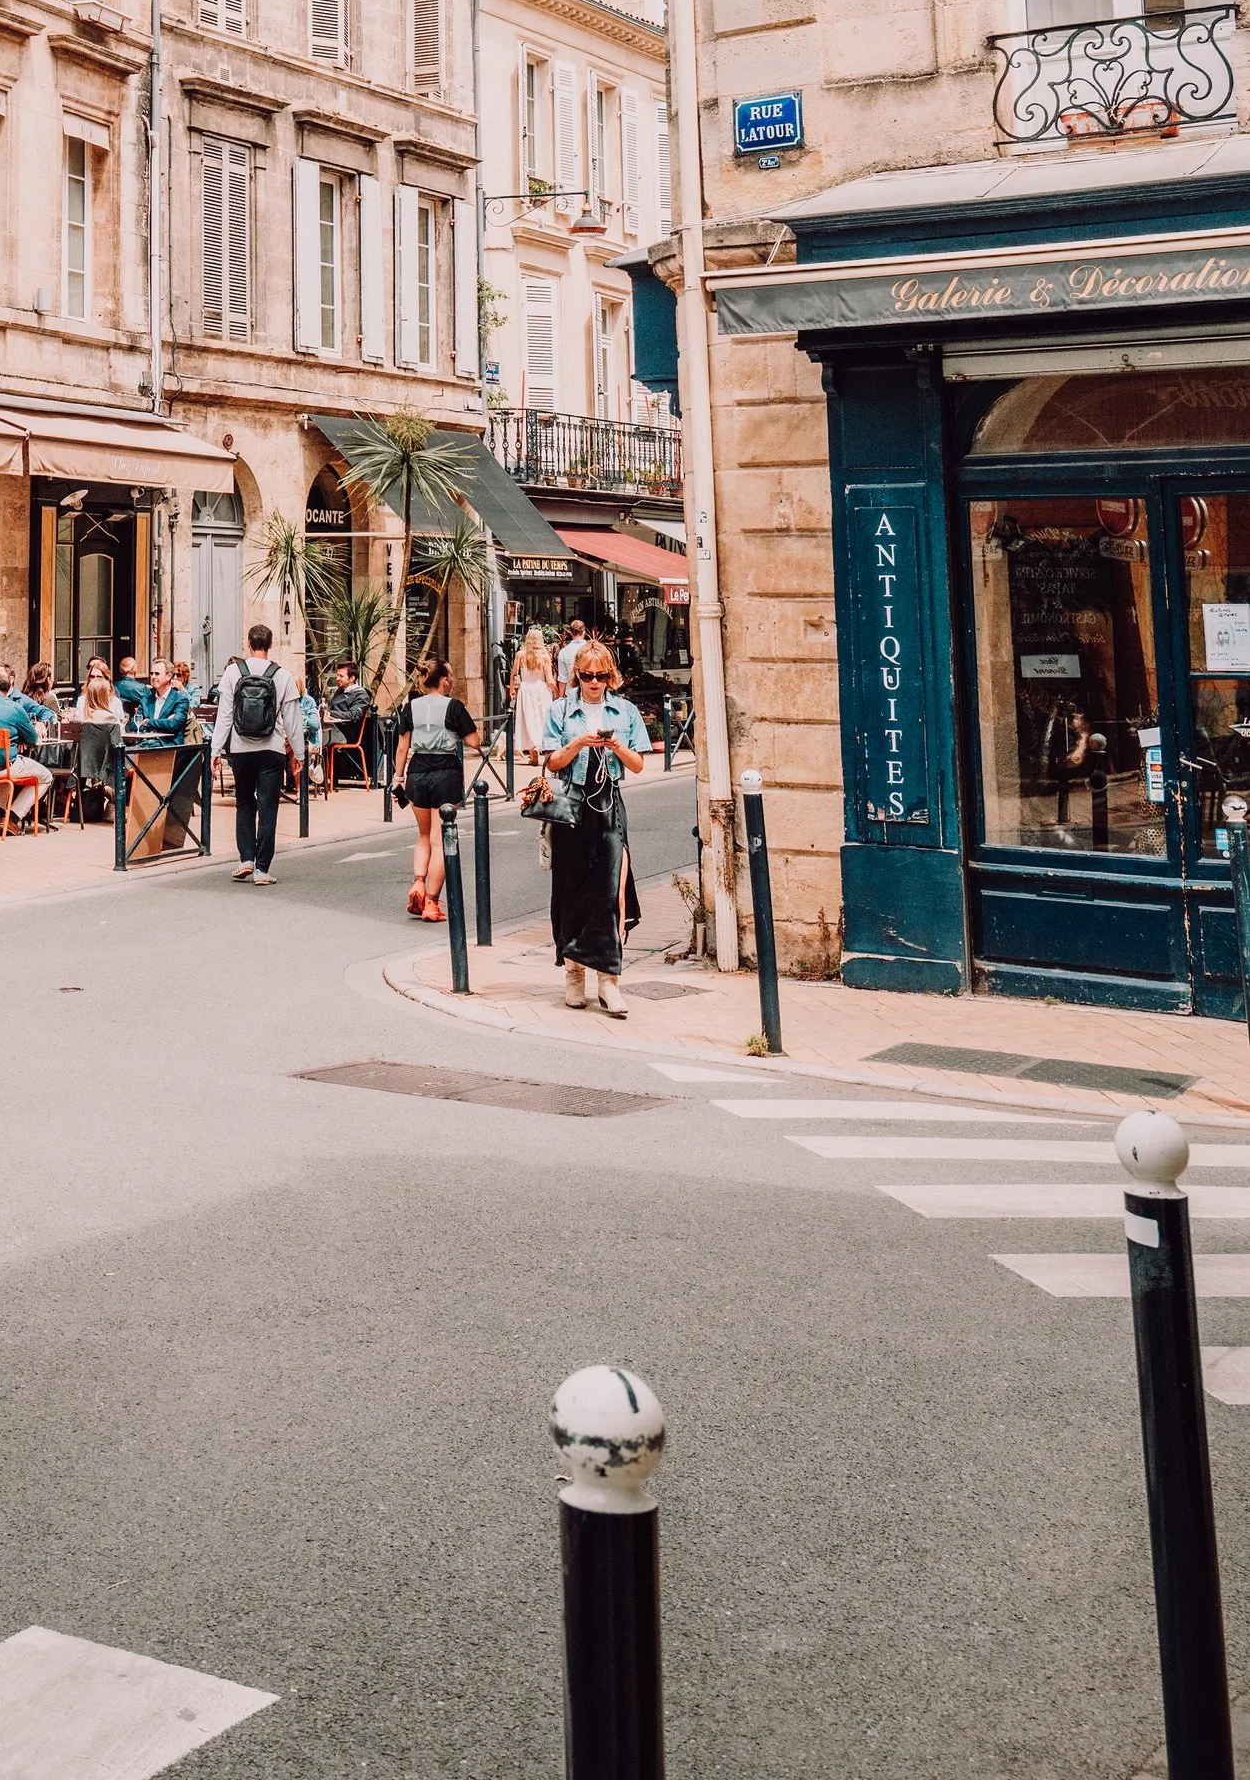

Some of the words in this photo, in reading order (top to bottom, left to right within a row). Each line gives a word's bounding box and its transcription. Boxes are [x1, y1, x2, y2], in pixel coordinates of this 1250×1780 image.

[750, 103, 783, 121] RUE
[740, 123, 795, 143] LATOUR
[890, 278, 1012, 312] Galerie
[1029, 278, 1053, 308] &
[306, 508, 344, 524] OCANTE
[513, 558, 521, 569] LA
[522, 559, 541, 570] PATINE
[541, 559, 550, 570] DU
[550, 560, 568, 571] TEMPS
[671, 588, 679, 601] Le
[874, 513, 905, 817] ANTIQUITES
